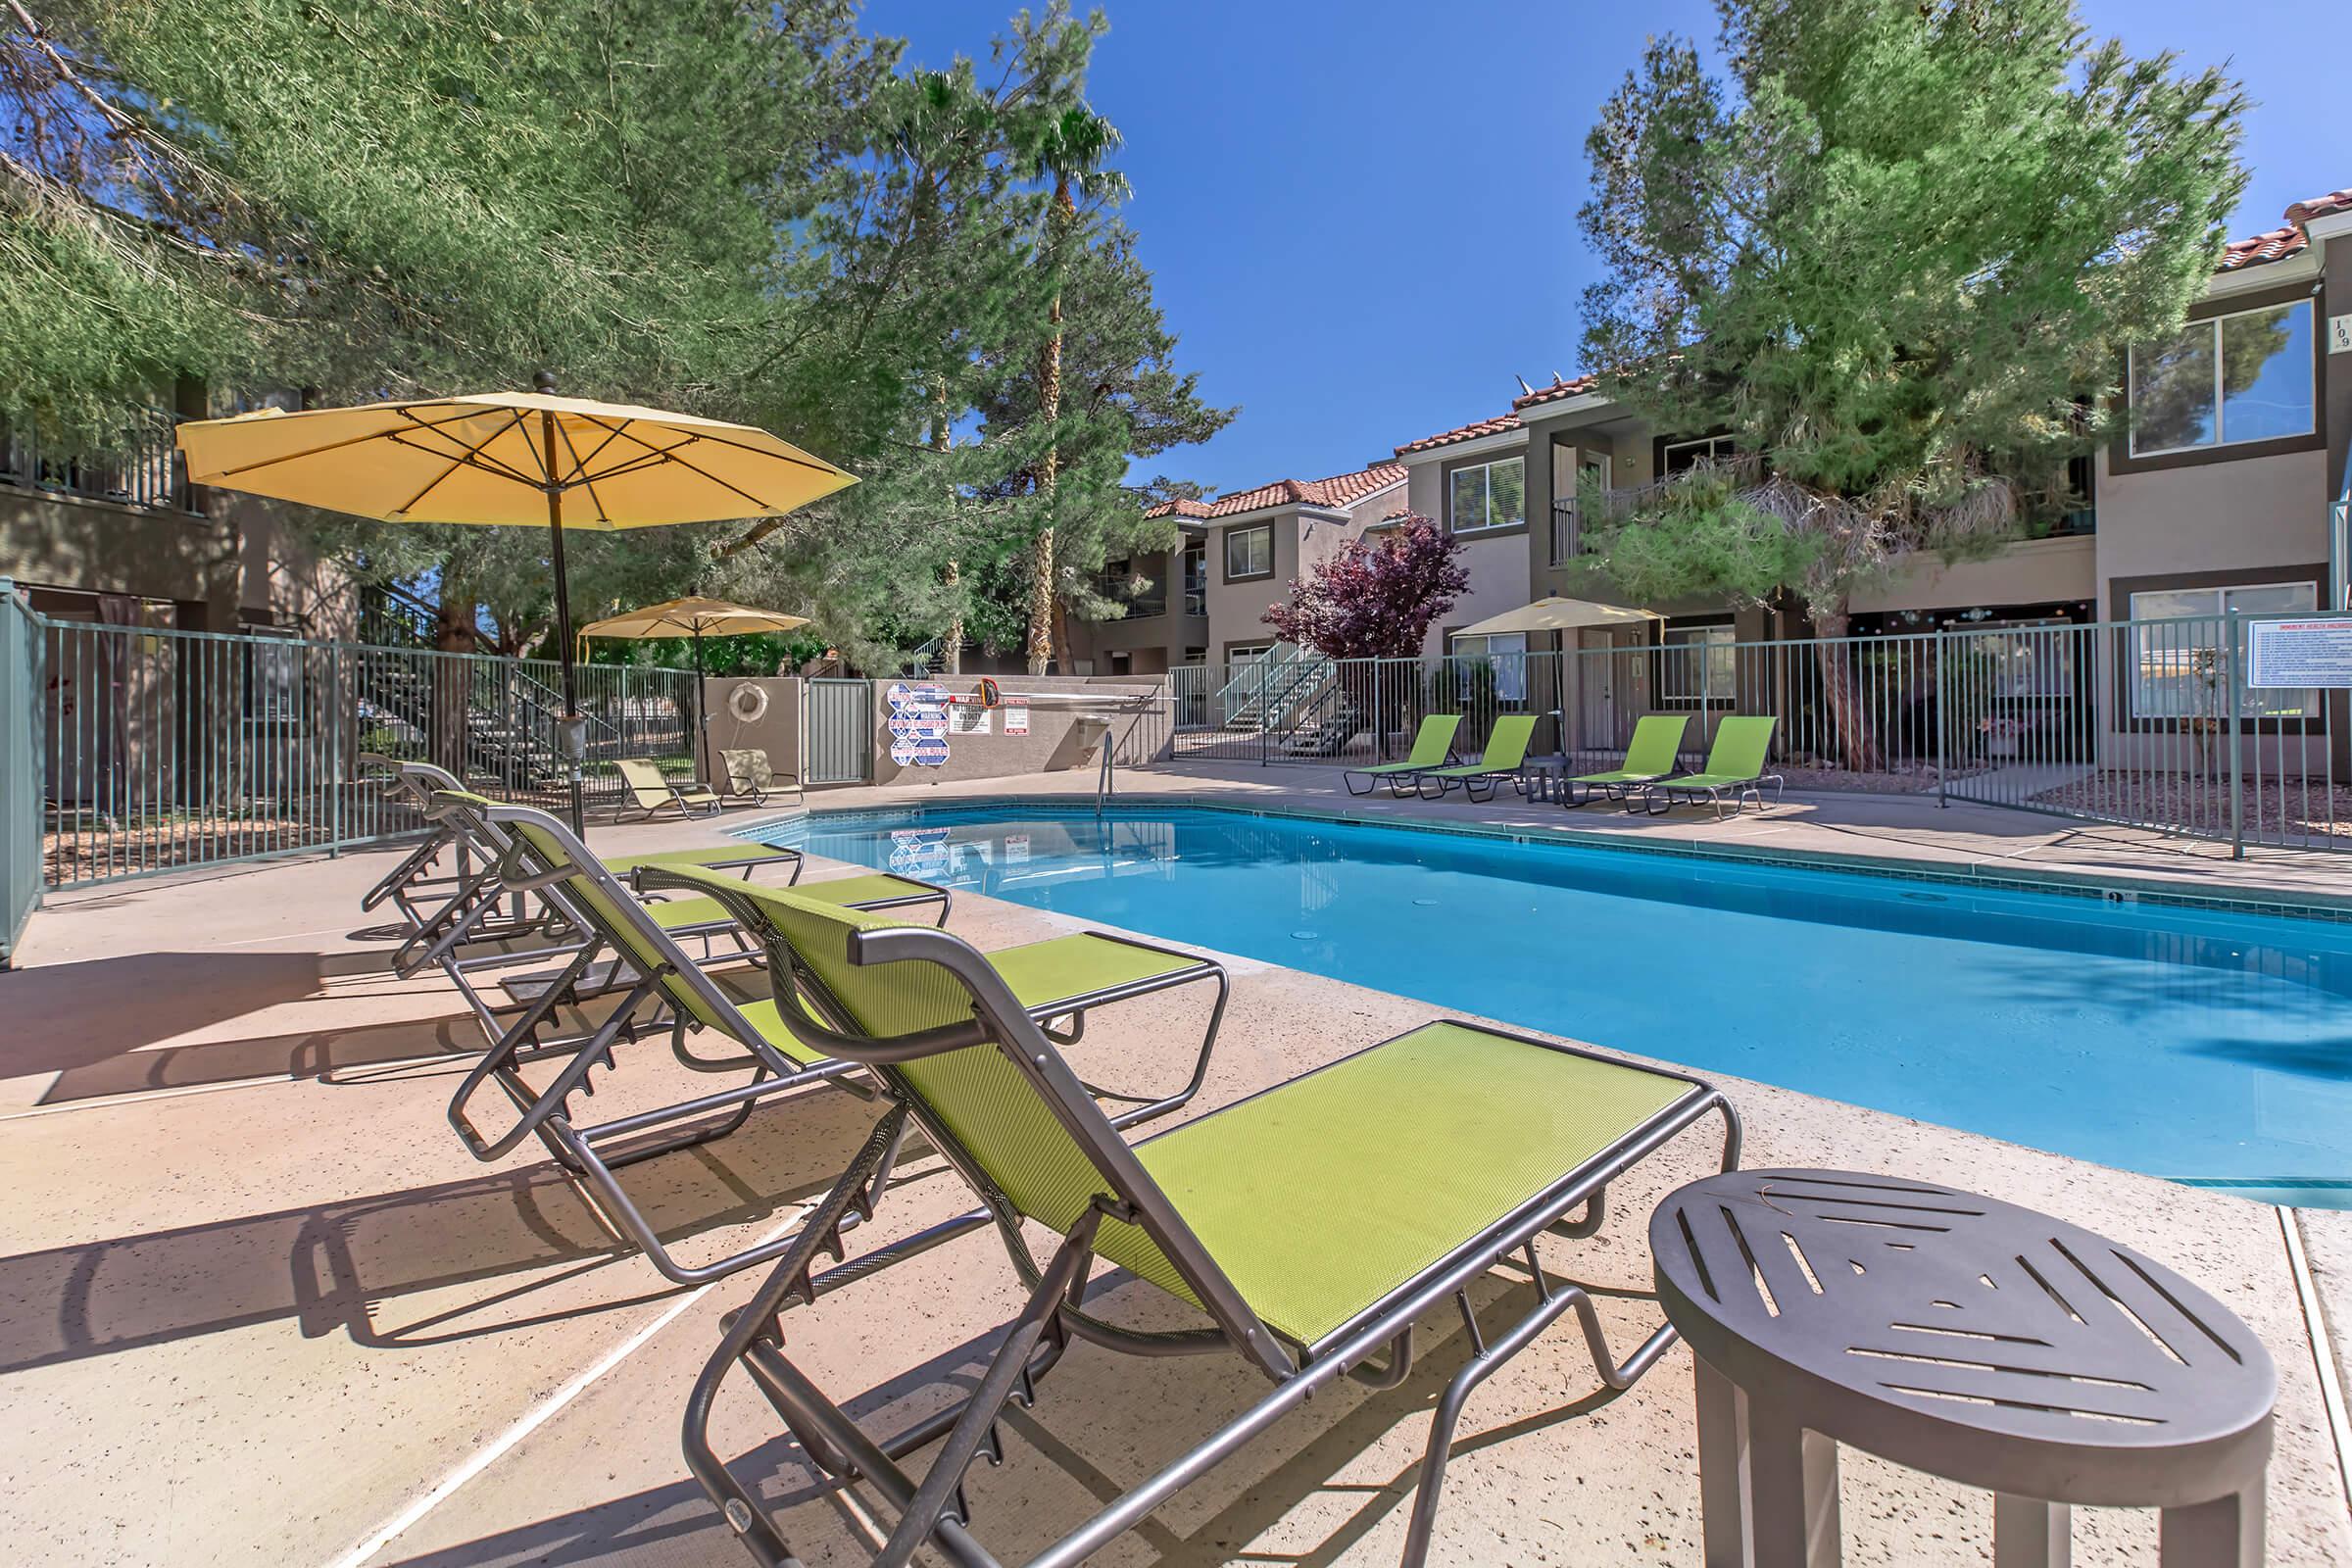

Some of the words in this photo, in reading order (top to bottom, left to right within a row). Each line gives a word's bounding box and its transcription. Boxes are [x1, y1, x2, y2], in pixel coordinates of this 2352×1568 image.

[2336, 319, 2350, 347] 109
[889, 720, 912, 729] DIVING
[913, 747, 928, 756] POOL
[929, 747, 949, 756] RULES
